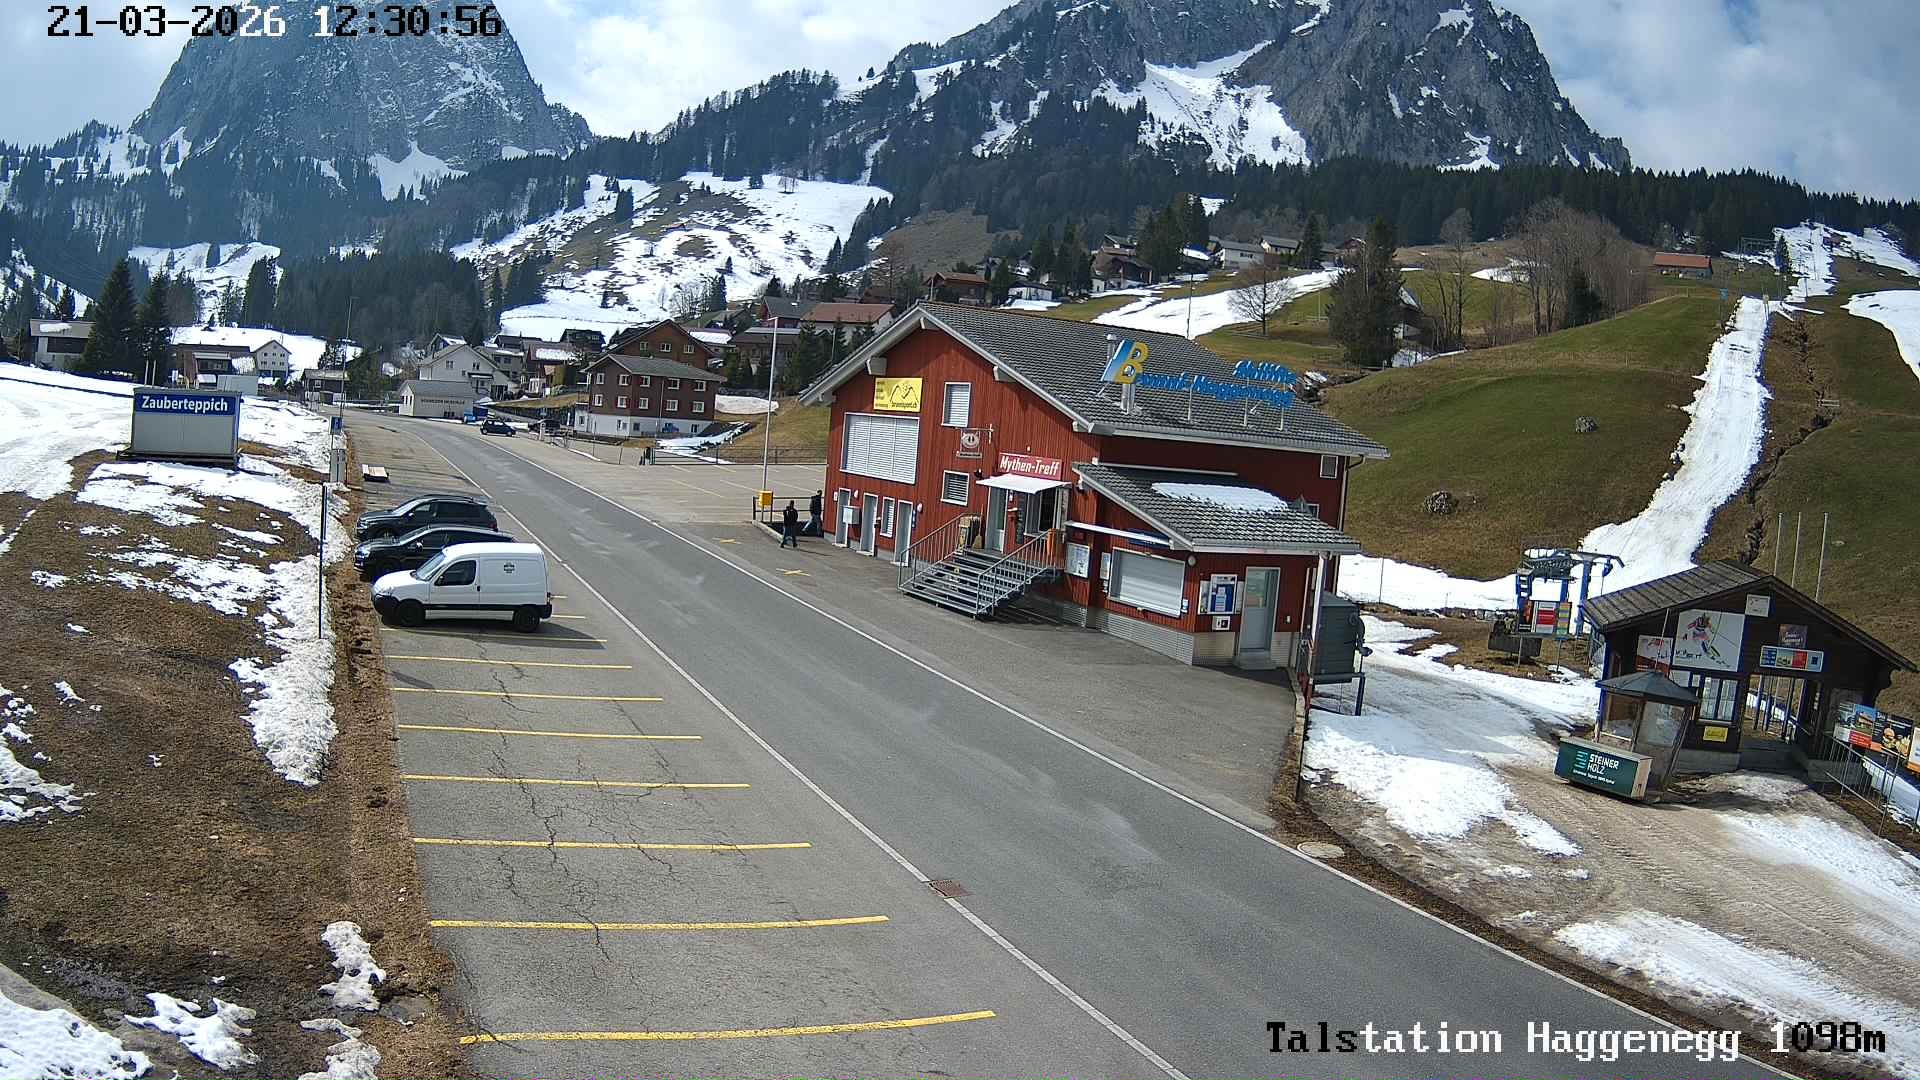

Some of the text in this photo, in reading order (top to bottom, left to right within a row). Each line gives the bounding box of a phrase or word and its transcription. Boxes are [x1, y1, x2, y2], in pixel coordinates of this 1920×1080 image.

[141, 395, 228, 413] Zauberteppich
[1000, 455, 1060, 476] Mythen-Treff
[1587, 762, 1606, 775] HOLZ
[1589, 753, 1620, 770] STEINER
